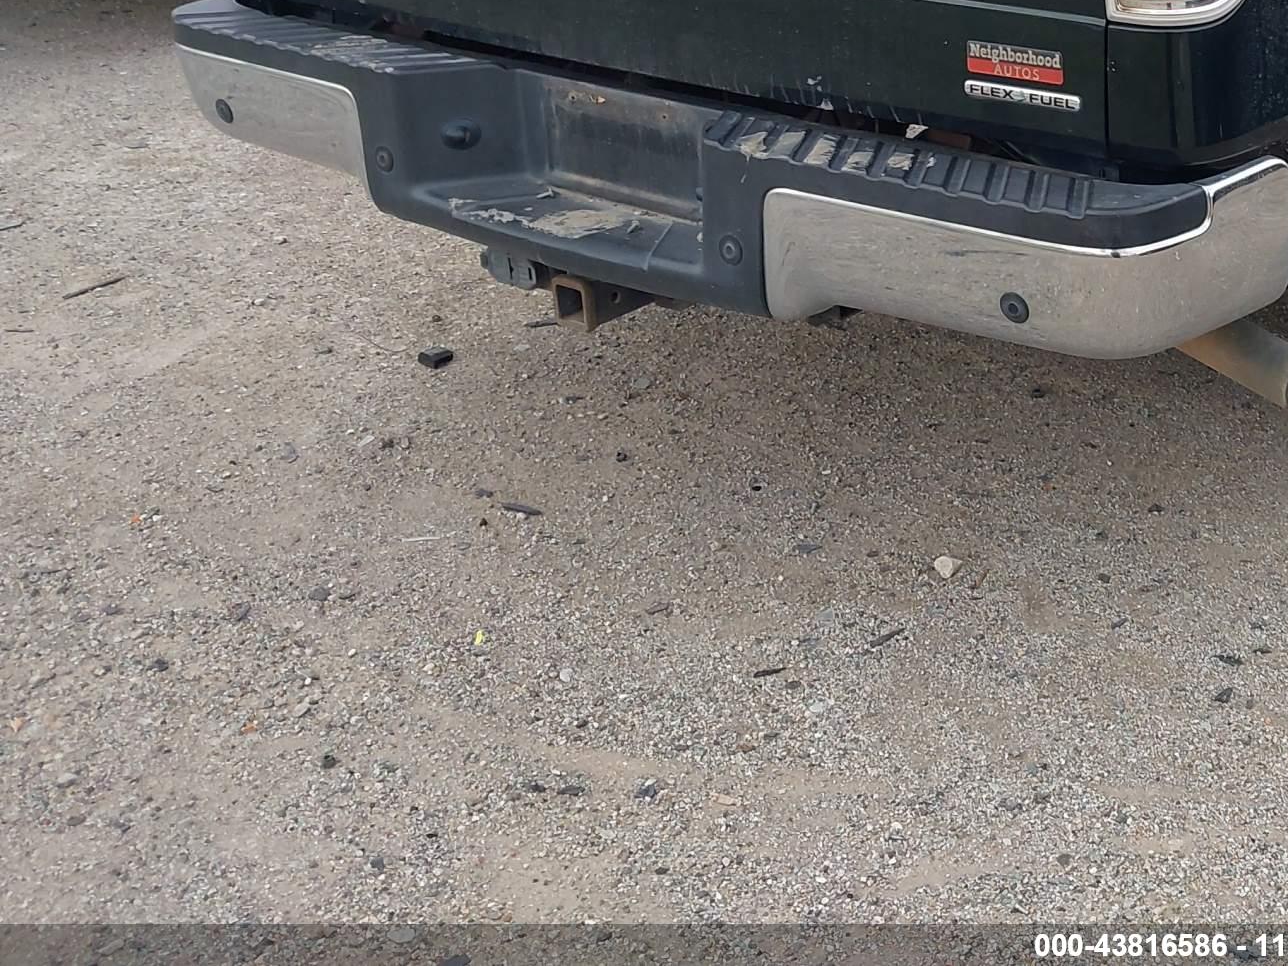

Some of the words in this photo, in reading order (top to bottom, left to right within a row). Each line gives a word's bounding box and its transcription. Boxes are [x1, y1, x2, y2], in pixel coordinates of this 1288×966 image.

[969, 42, 1062, 68] Neighborhood
[993, 64, 1040, 81] AUTOS
[969, 84, 1014, 100] FLEX
[1029, 93, 1076, 110] FUEL
